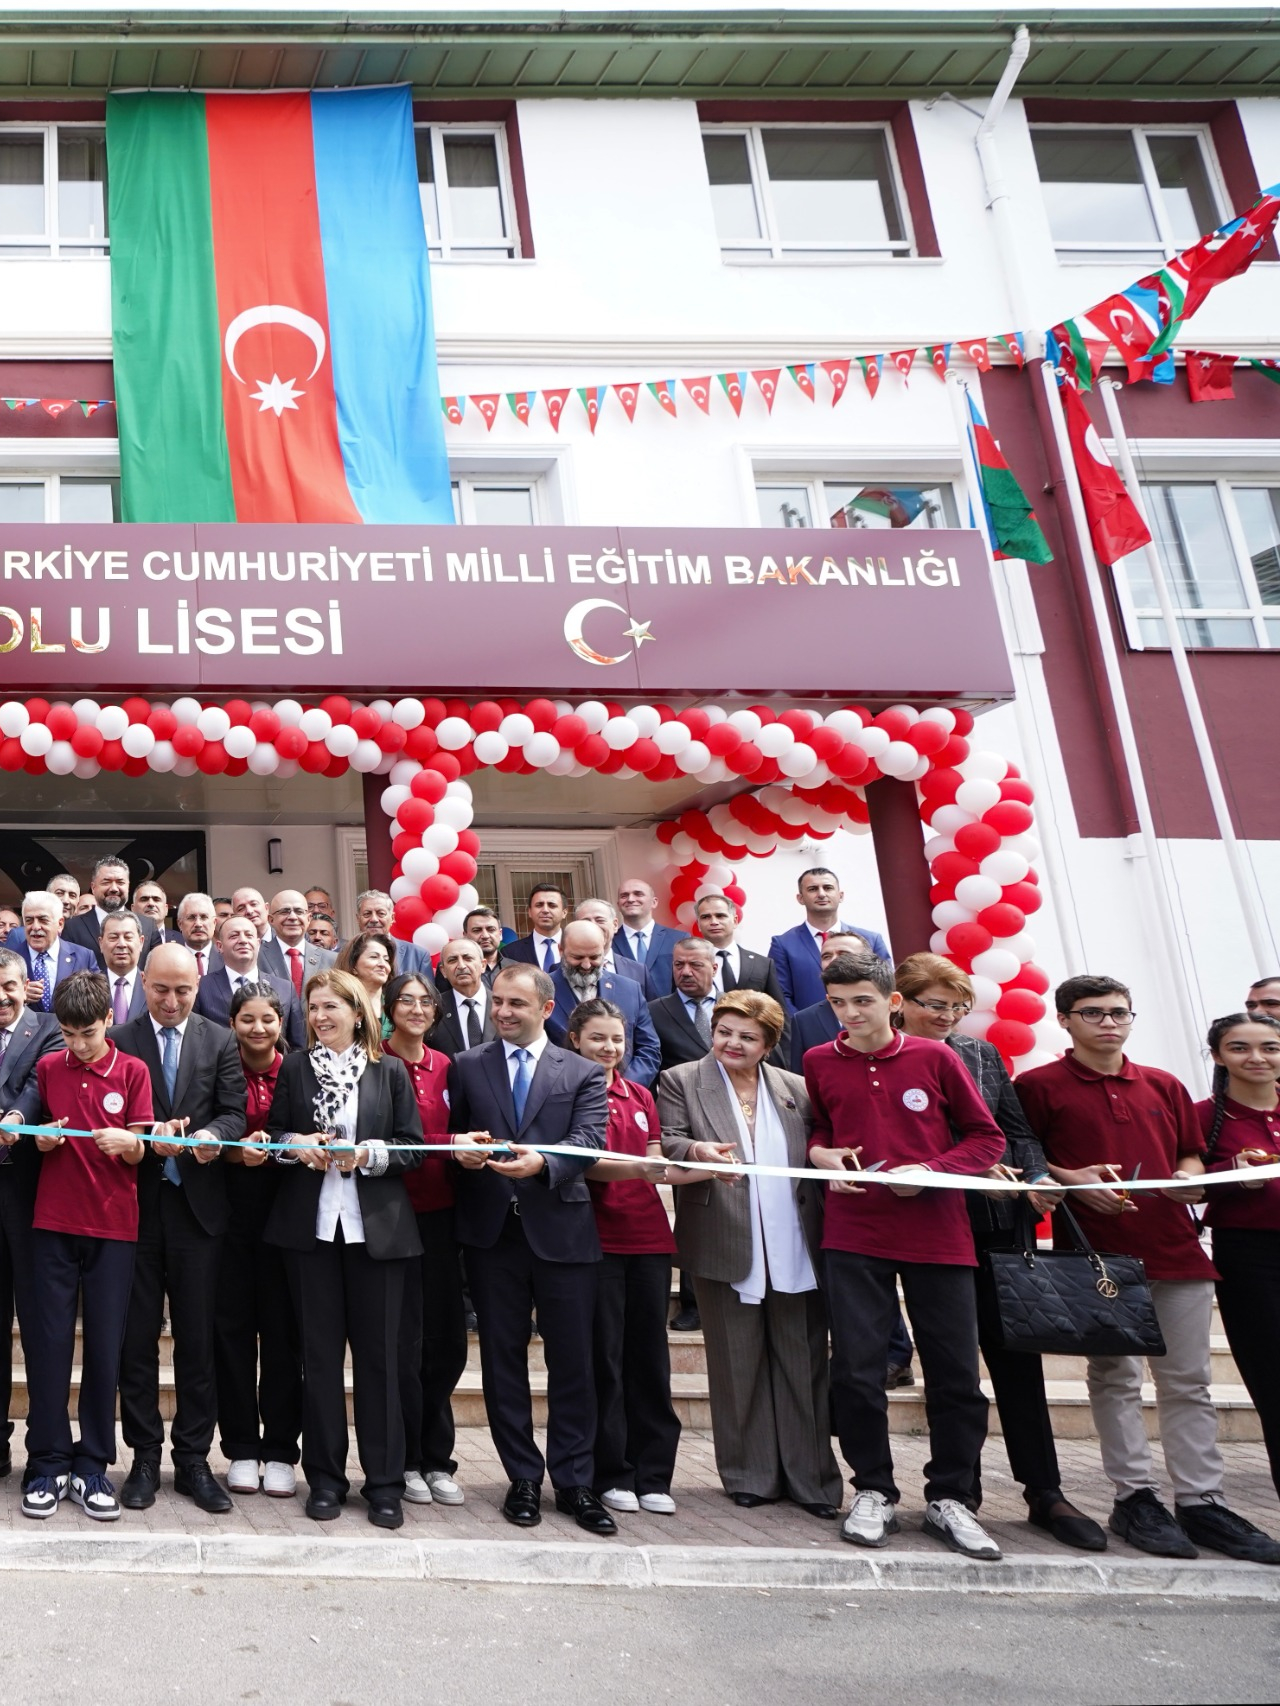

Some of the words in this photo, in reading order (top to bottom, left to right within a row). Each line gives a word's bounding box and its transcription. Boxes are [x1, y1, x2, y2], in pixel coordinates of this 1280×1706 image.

[142, 546, 433, 582] CUMHURİYETİ
[446, 547, 555, 583] MİLLİ
[567, 548, 712, 585] EĞİTİM
[724, 549, 961, 587] BAKANLIĞI
[137, 599, 343, 655] LİSESİ
